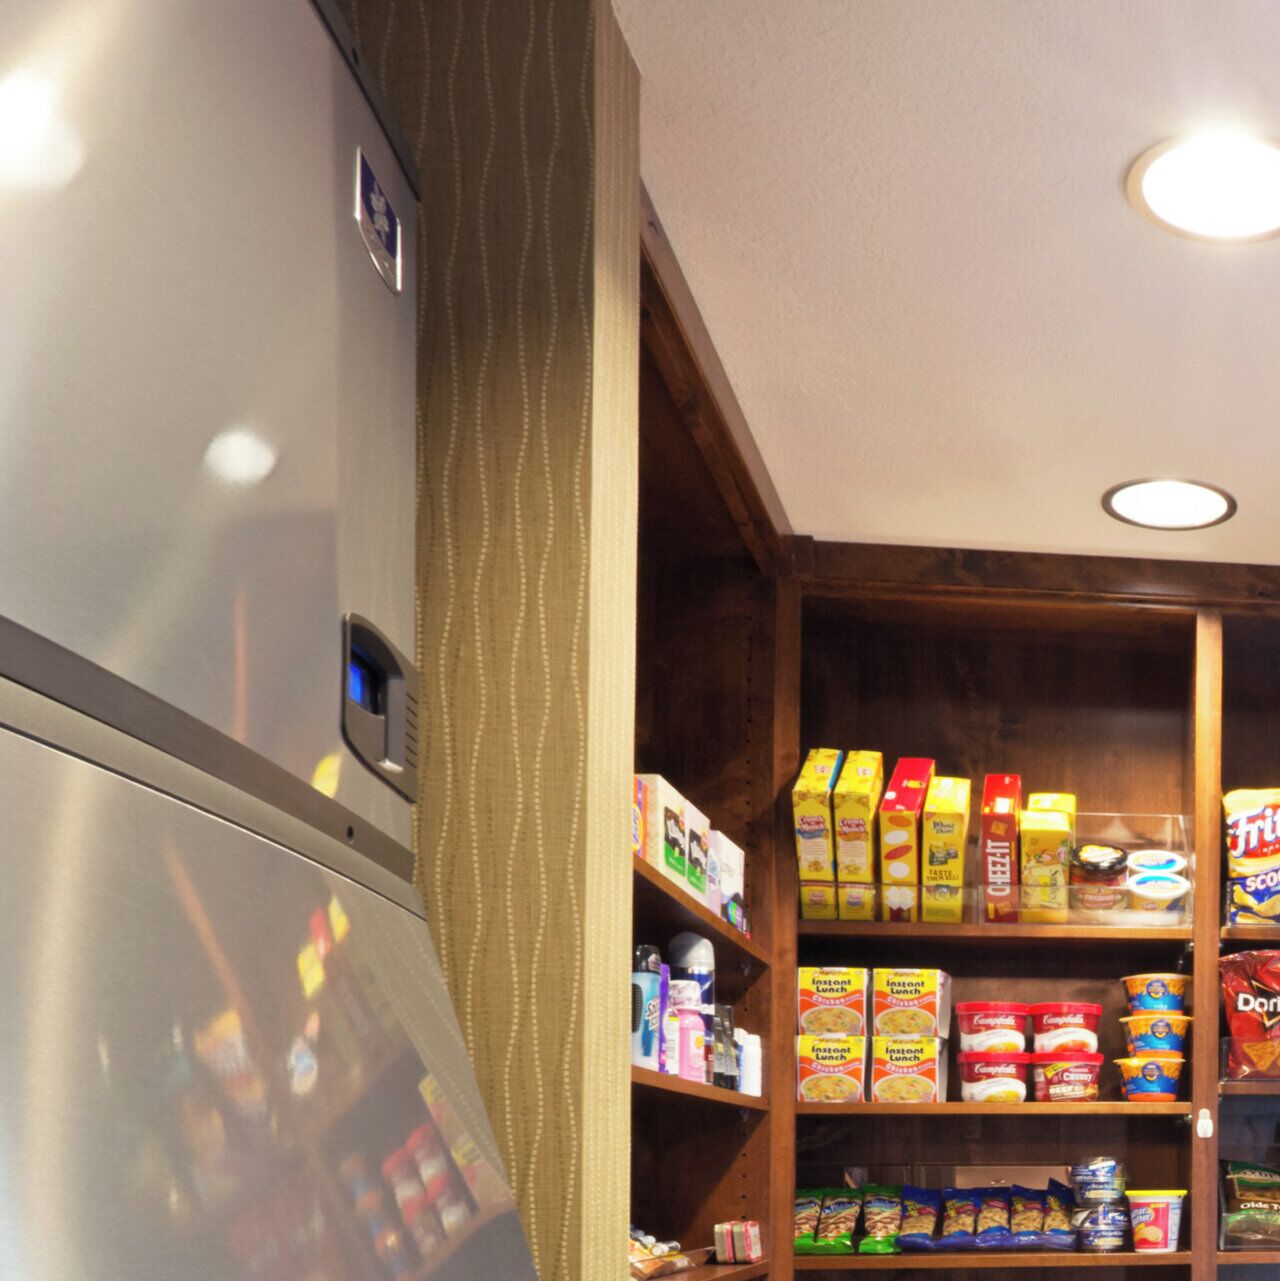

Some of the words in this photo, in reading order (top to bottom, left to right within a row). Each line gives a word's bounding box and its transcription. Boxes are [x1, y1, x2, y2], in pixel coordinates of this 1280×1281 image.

[986, 840, 1011, 896] CHEEZ-IT
[885, 1047, 924, 1055] Instant
[815, 1053, 847, 1061] Lunch
[889, 1054, 921, 1062] Lunch
[1240, 1201, 1270, 1210] Olde
